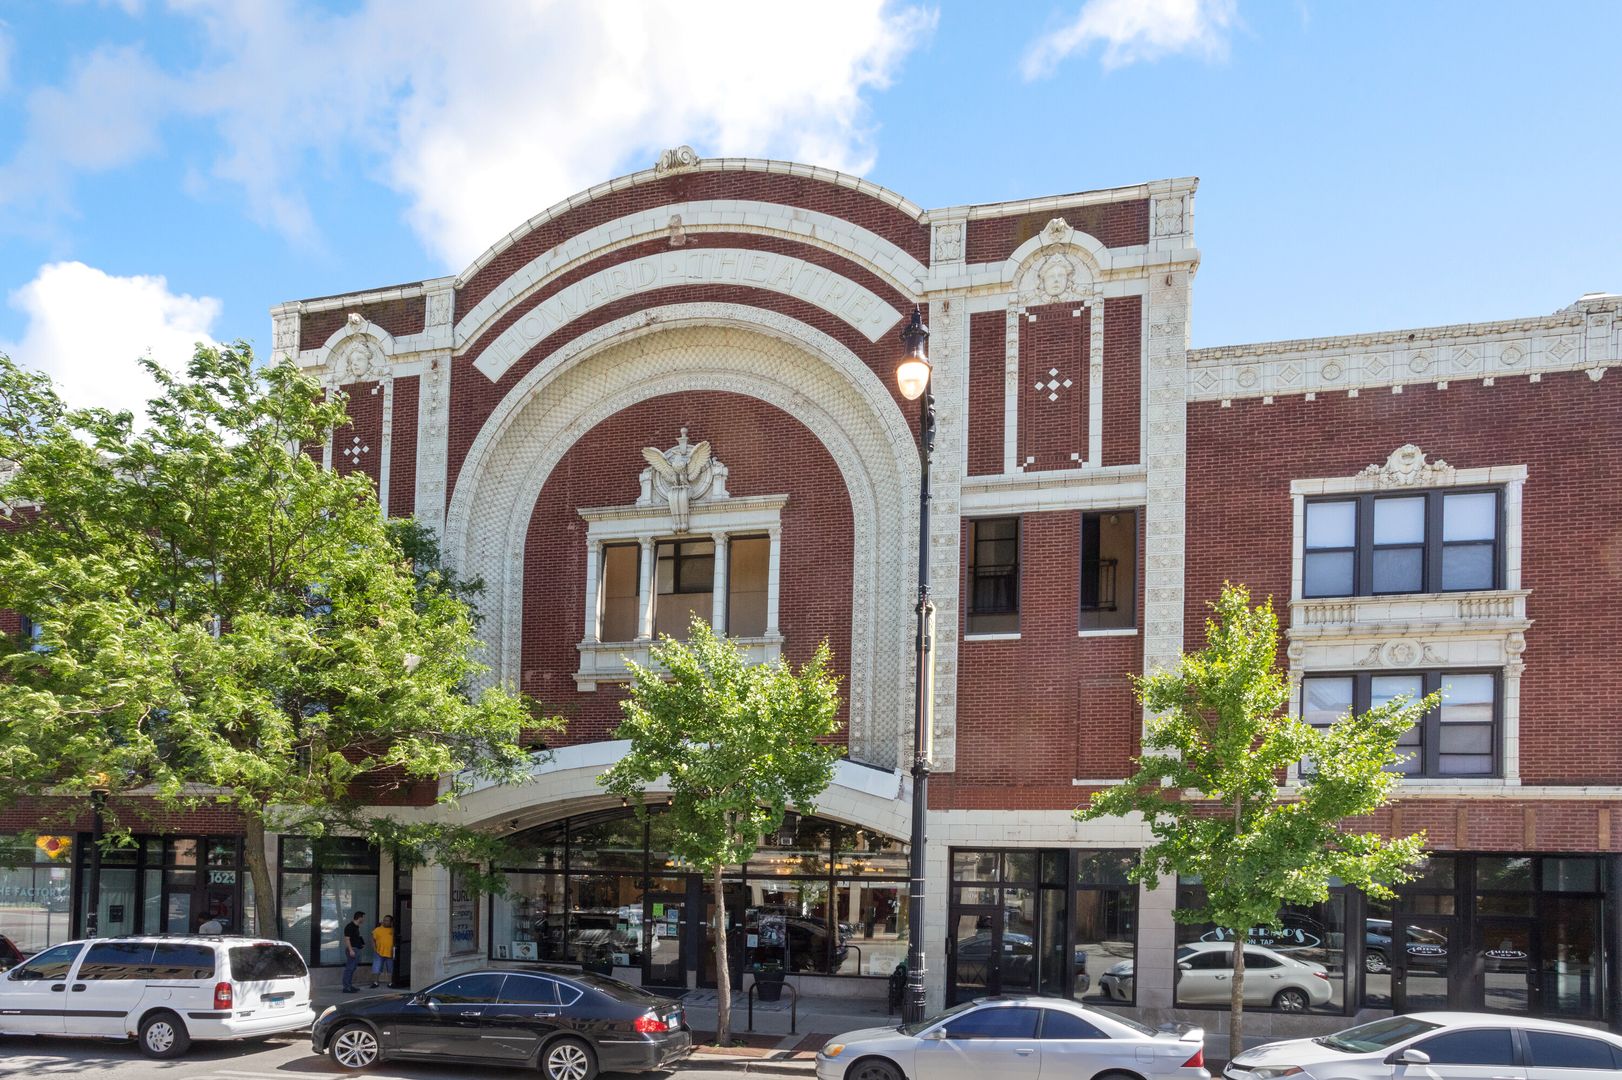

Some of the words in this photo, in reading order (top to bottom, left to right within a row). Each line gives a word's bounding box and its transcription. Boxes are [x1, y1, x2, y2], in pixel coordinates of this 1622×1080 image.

[495, 262, 657, 363] HOWARD
[688, 251, 875, 324] THEATRE
[209, 872, 236, 884] 1623
[1215, 926, 1305, 944] SAERNO'S
